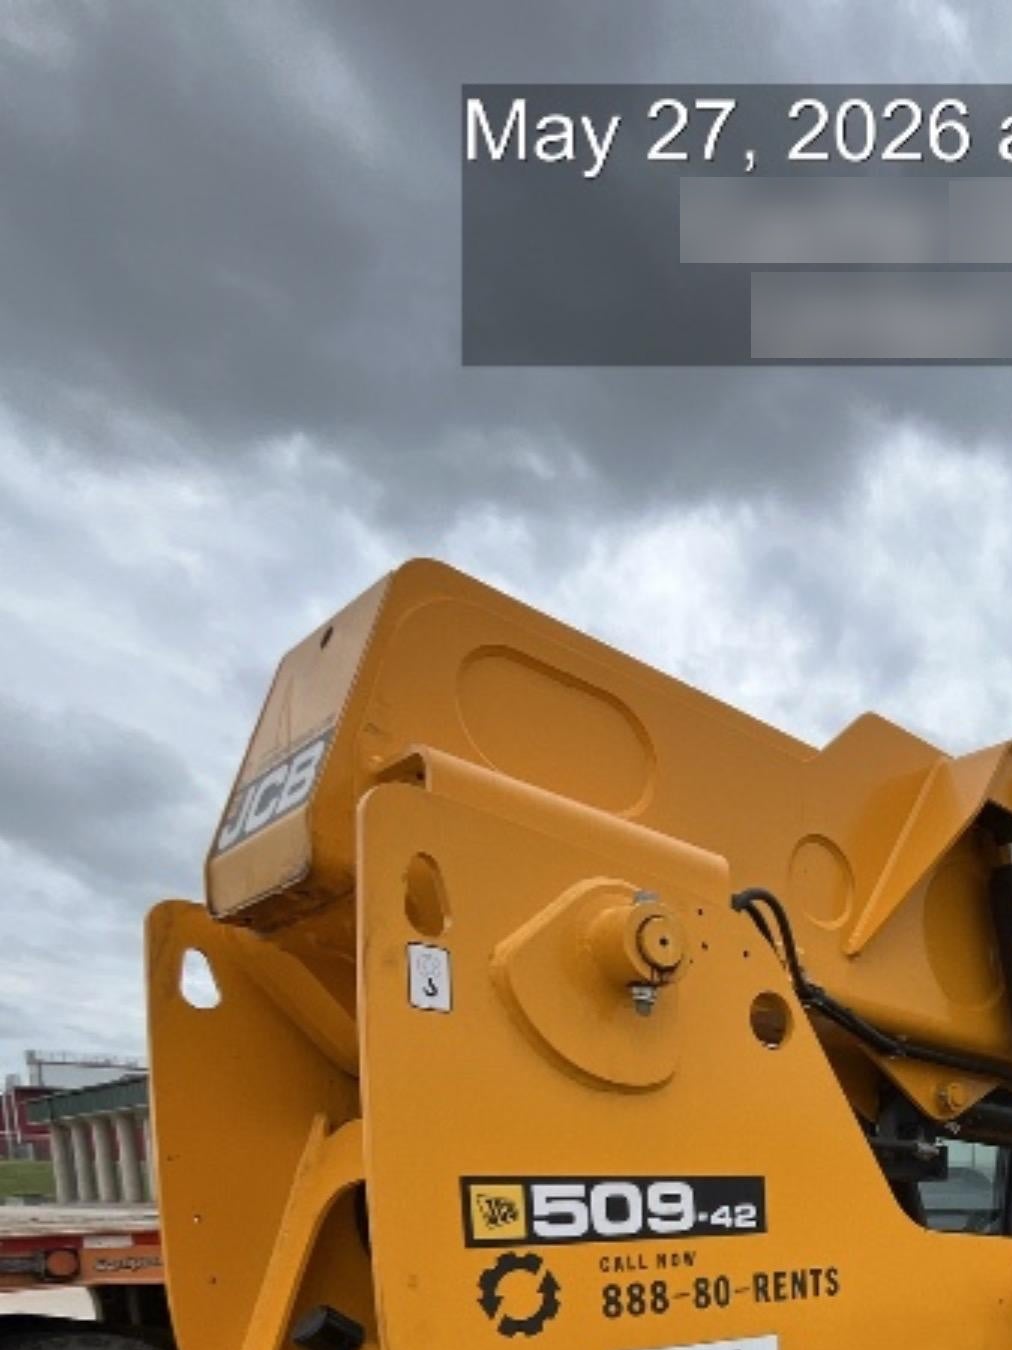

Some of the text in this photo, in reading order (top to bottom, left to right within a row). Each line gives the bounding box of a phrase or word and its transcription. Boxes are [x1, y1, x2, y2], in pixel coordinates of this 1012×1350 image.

[217, 739, 326, 851] JCB
[530, 1181, 758, 1238] 509-42
[600, 1253, 649, 1273] CALL
[602, 1267, 841, 1319] 888-80-RENTS
